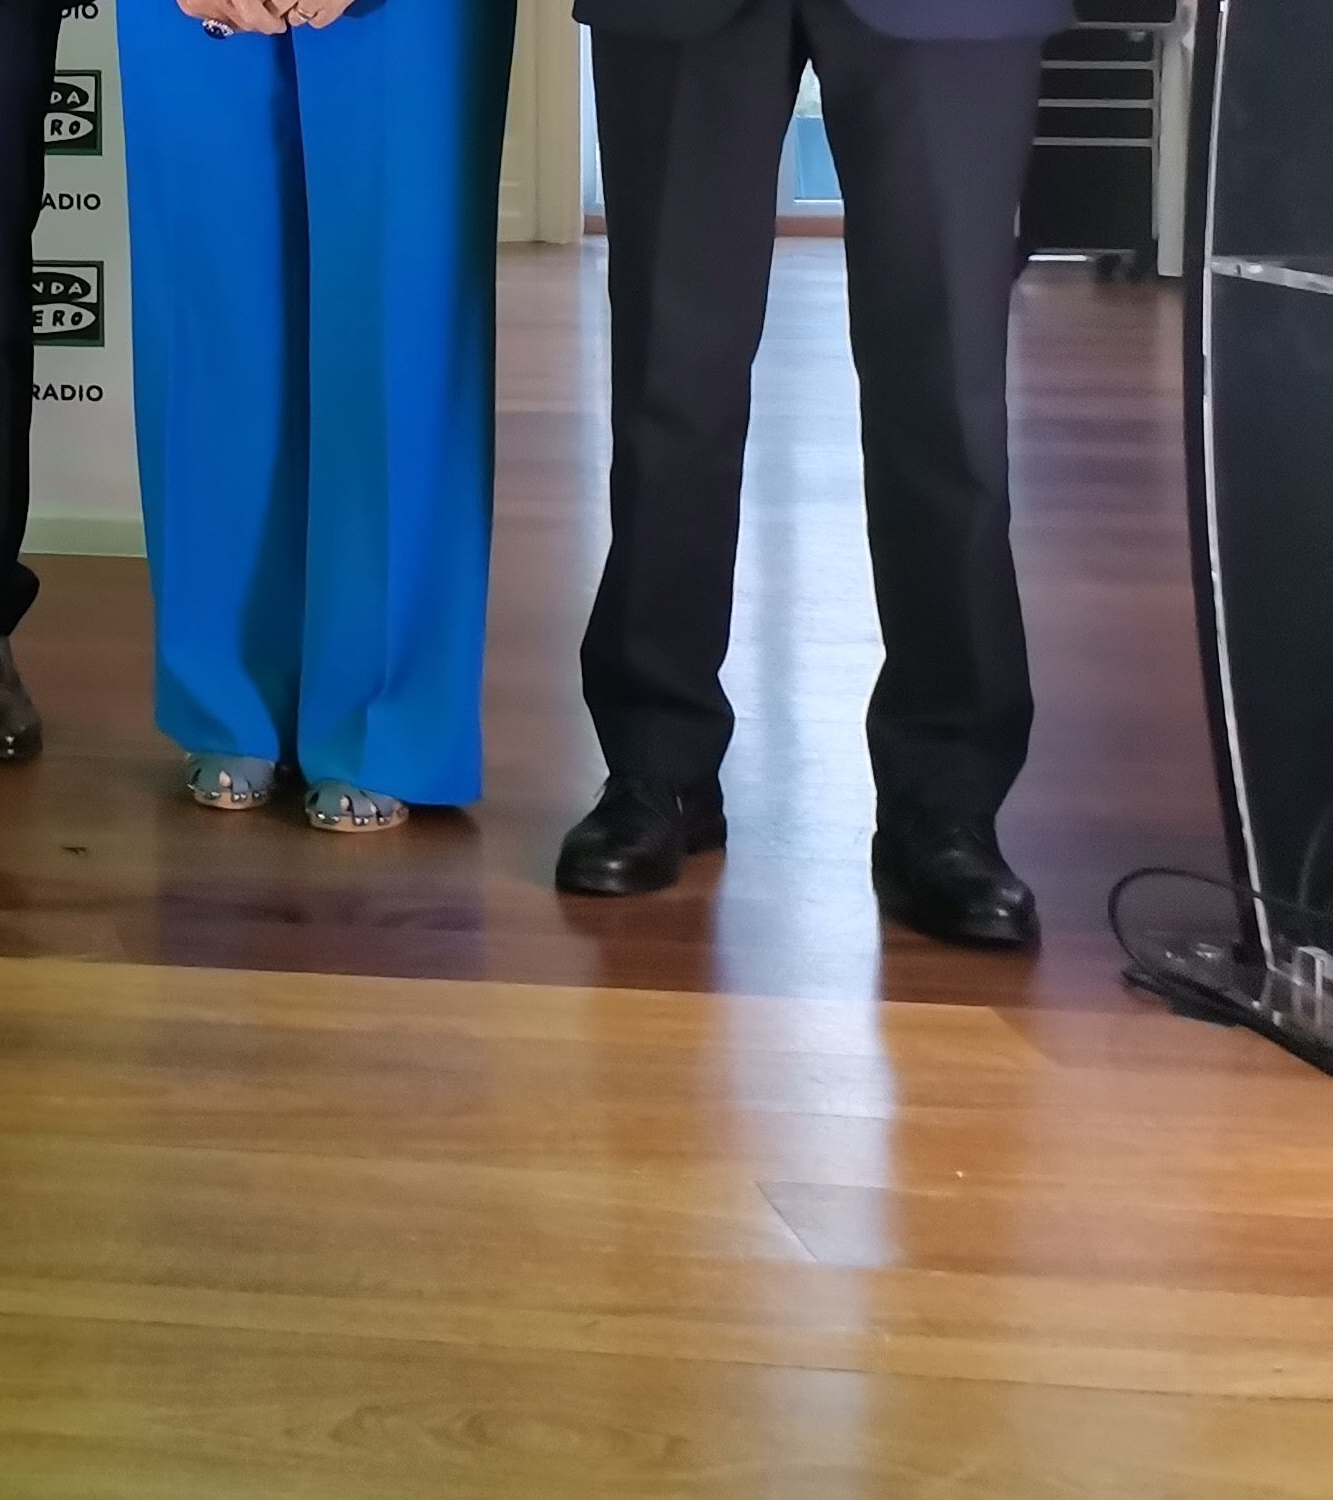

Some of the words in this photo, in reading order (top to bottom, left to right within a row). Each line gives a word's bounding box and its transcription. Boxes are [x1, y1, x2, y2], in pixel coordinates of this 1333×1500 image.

[50, 90, 81, 105] DA
[50, 118, 81, 136] RO
[41, 192, 101, 211] ADIO
[32, 281, 83, 295] NDA
[33, 309, 83, 327] ERO
